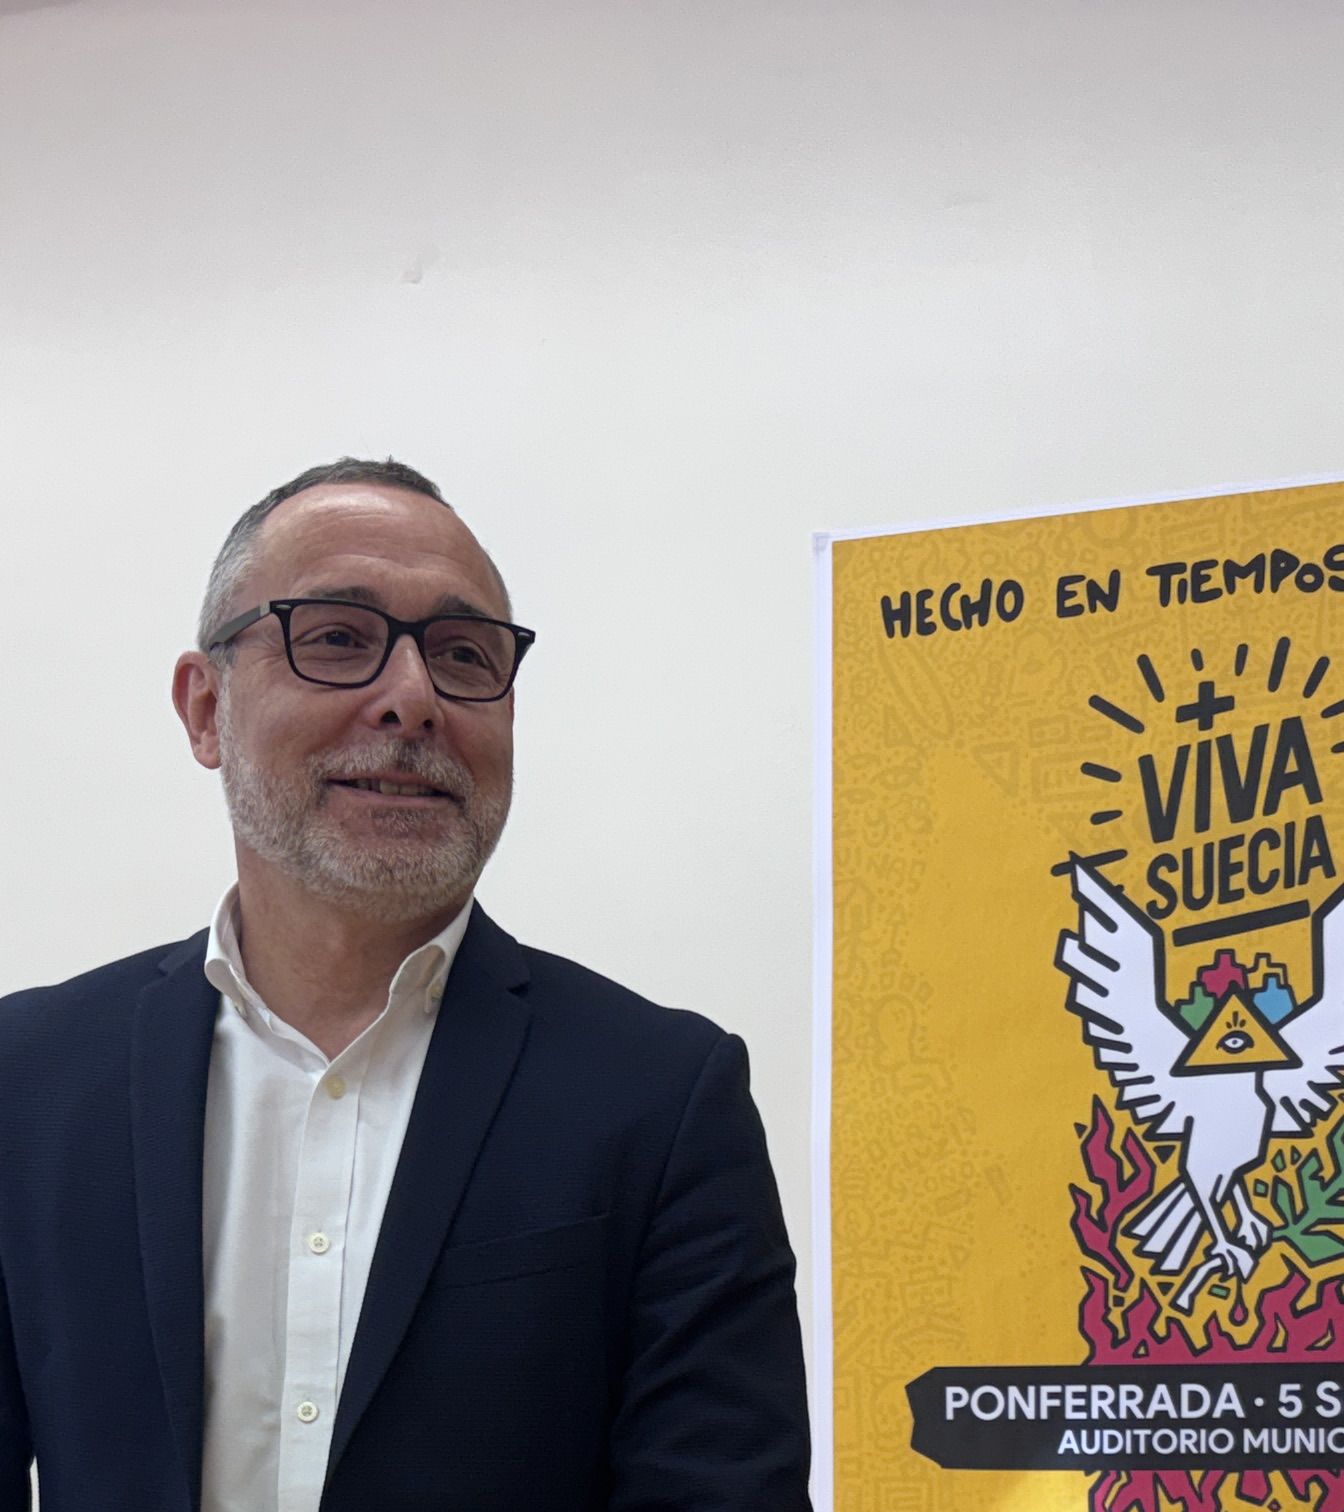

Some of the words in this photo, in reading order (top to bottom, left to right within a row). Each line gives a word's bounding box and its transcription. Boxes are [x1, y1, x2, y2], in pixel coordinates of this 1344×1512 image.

[881, 578, 1024, 639] HECHO
[1056, 569, 1121, 618] EN
[1138, 716, 1323, 843] VIVA
[1146, 815, 1337, 921] SUECIA
[945, 1382, 1245, 1421] PONFERRADA
[1278, 1383, 1303, 1419] 5
[1057, 1427, 1235, 1456] AUDITORIO
